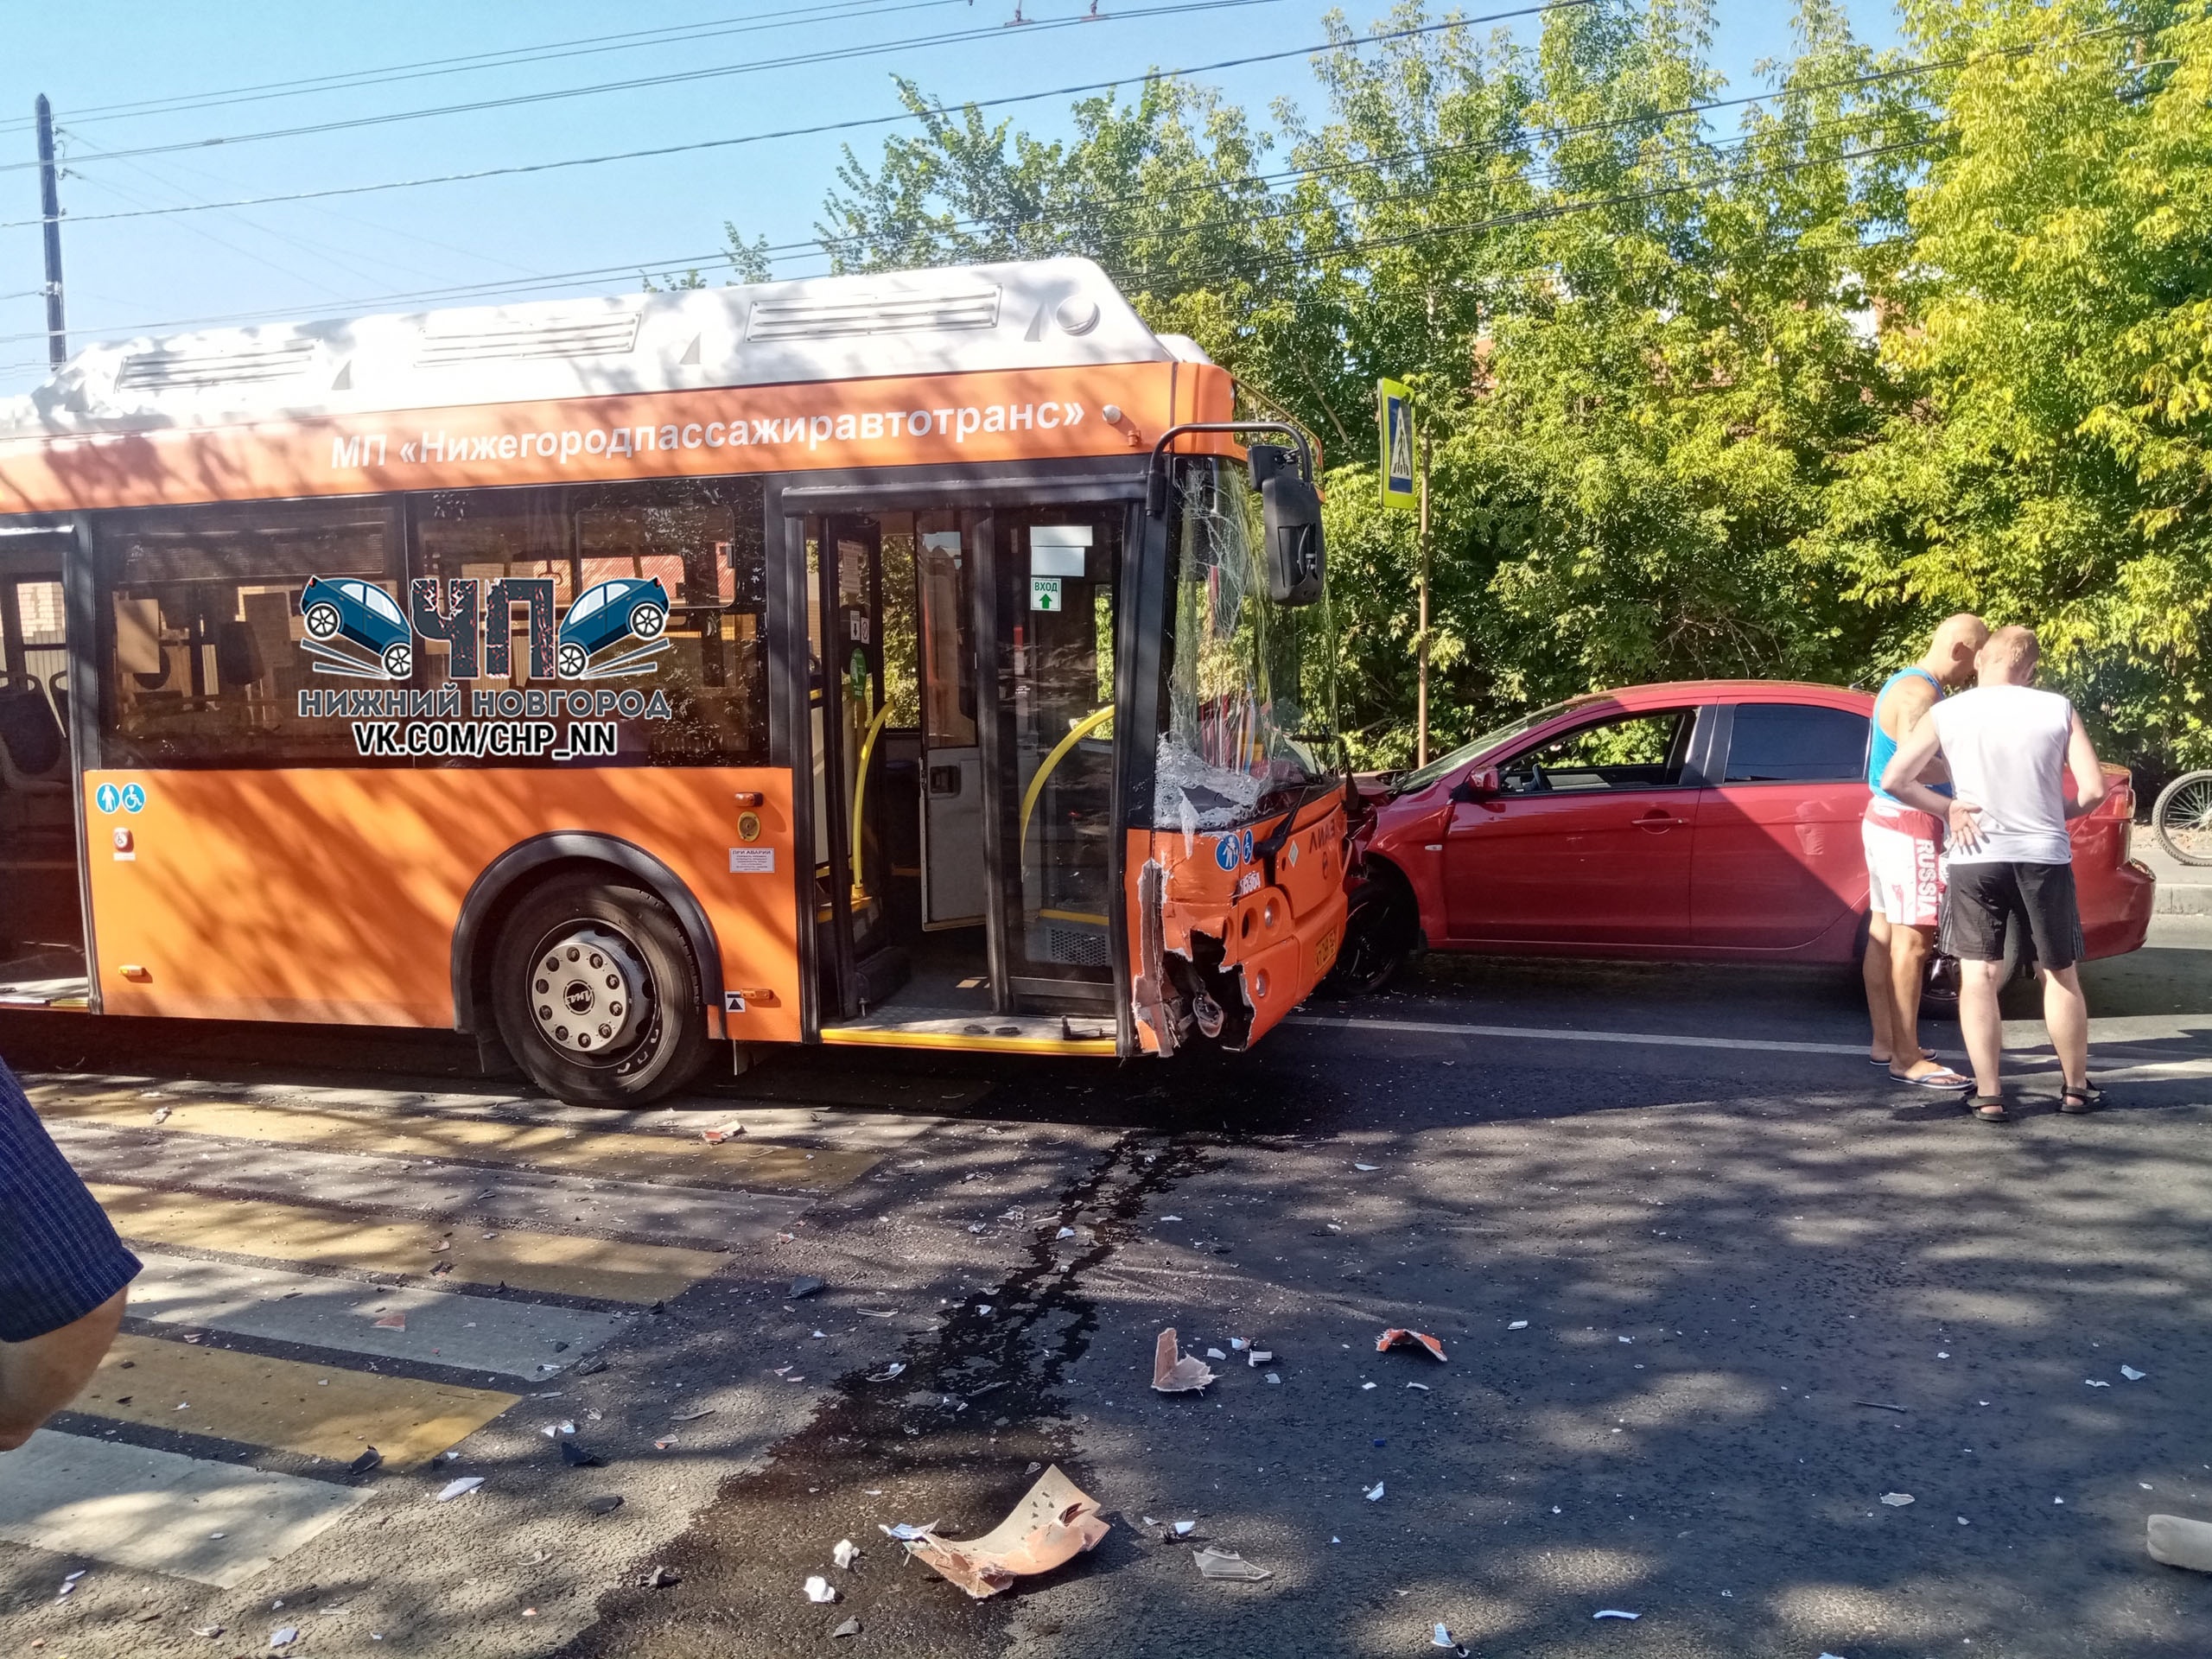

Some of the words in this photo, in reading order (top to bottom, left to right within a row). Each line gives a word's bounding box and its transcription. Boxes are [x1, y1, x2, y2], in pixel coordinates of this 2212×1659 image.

[331, 433, 387, 469] МП
[398, 400, 1085, 465] «Нижегородпассажиравтотранс»
[1034, 582, 1058, 593] ВХОД
[1916, 838, 1937, 918] RUSSIA
